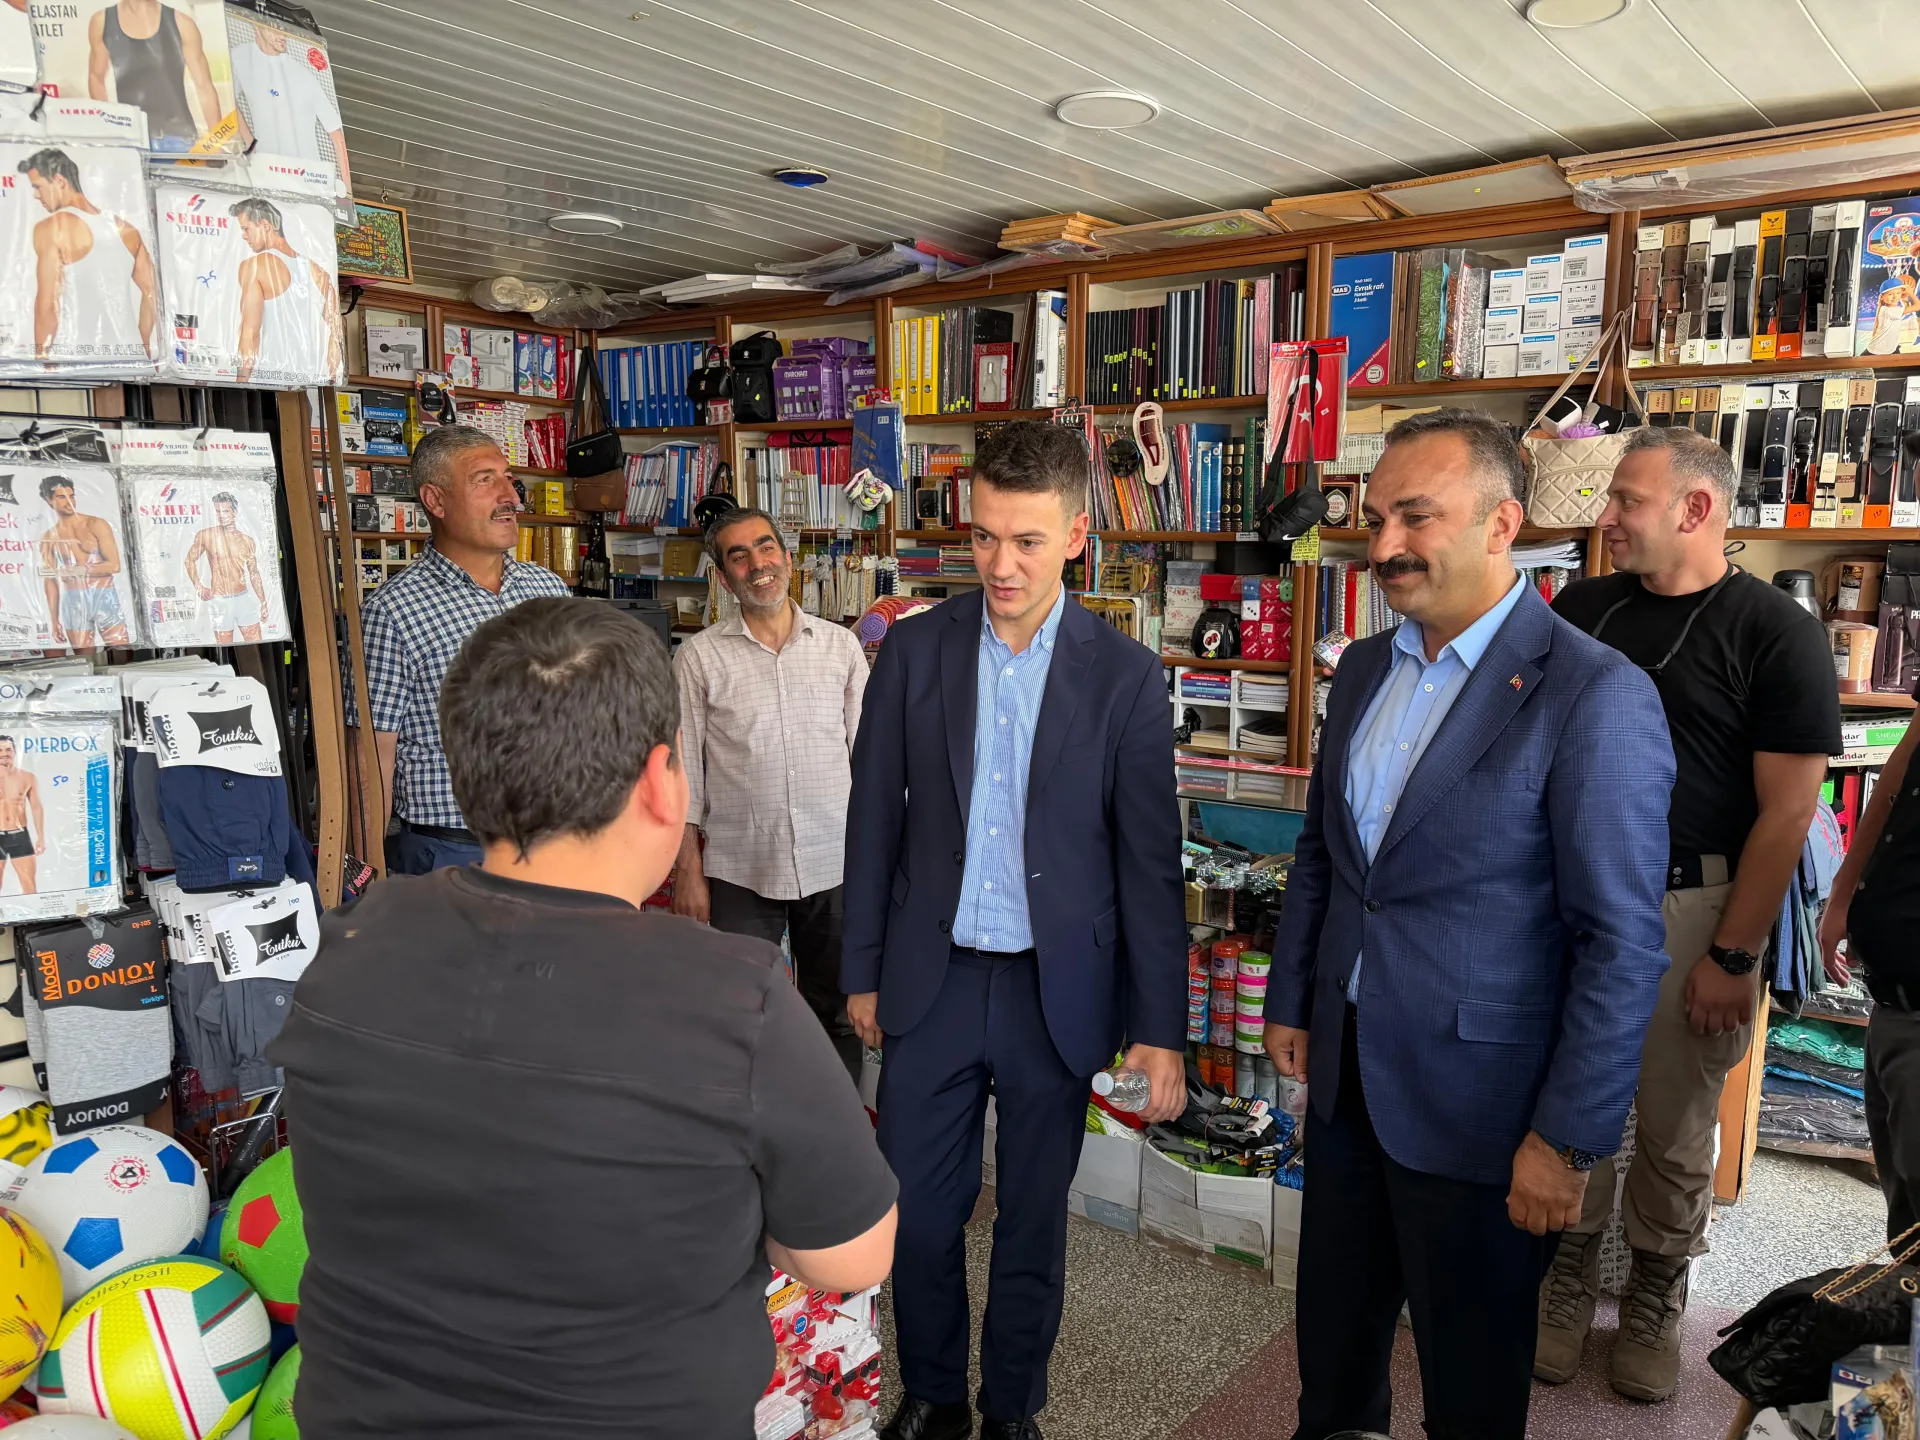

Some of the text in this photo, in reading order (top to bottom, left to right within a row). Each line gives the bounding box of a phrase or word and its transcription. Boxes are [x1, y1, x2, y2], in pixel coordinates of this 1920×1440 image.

[30, 4, 78, 18] ELASTAN
[202, 122, 235, 152] MODAL
[269, 165, 299, 175] SEHER
[166, 211, 228, 229] SEHER
[176, 224, 220, 237] YILDIZI
[1354, 284, 1372, 292] Evrak
[182, 330, 191, 340] M
[76, 344, 112, 356] SPOR
[126, 441, 156, 450] SEHER
[210, 443, 240, 451] SEHER
[140, 504, 202, 517] SEHER
[151, 516, 195, 525] YILDIZI
[162, 714, 181, 760] boxer
[1842, 733, 1860, 741] ndar
[24, 735, 98, 754] PIERBOX
[53, 775, 69, 788] 50
[94, 828, 106, 865] PIERBOX
[193, 913, 207, 957] boxer
[223, 929, 241, 974] boxer
[37, 950, 63, 1001] Modal
[66, 961, 156, 995] DONJOY
[65, 1101, 129, 1128] DONJOY
